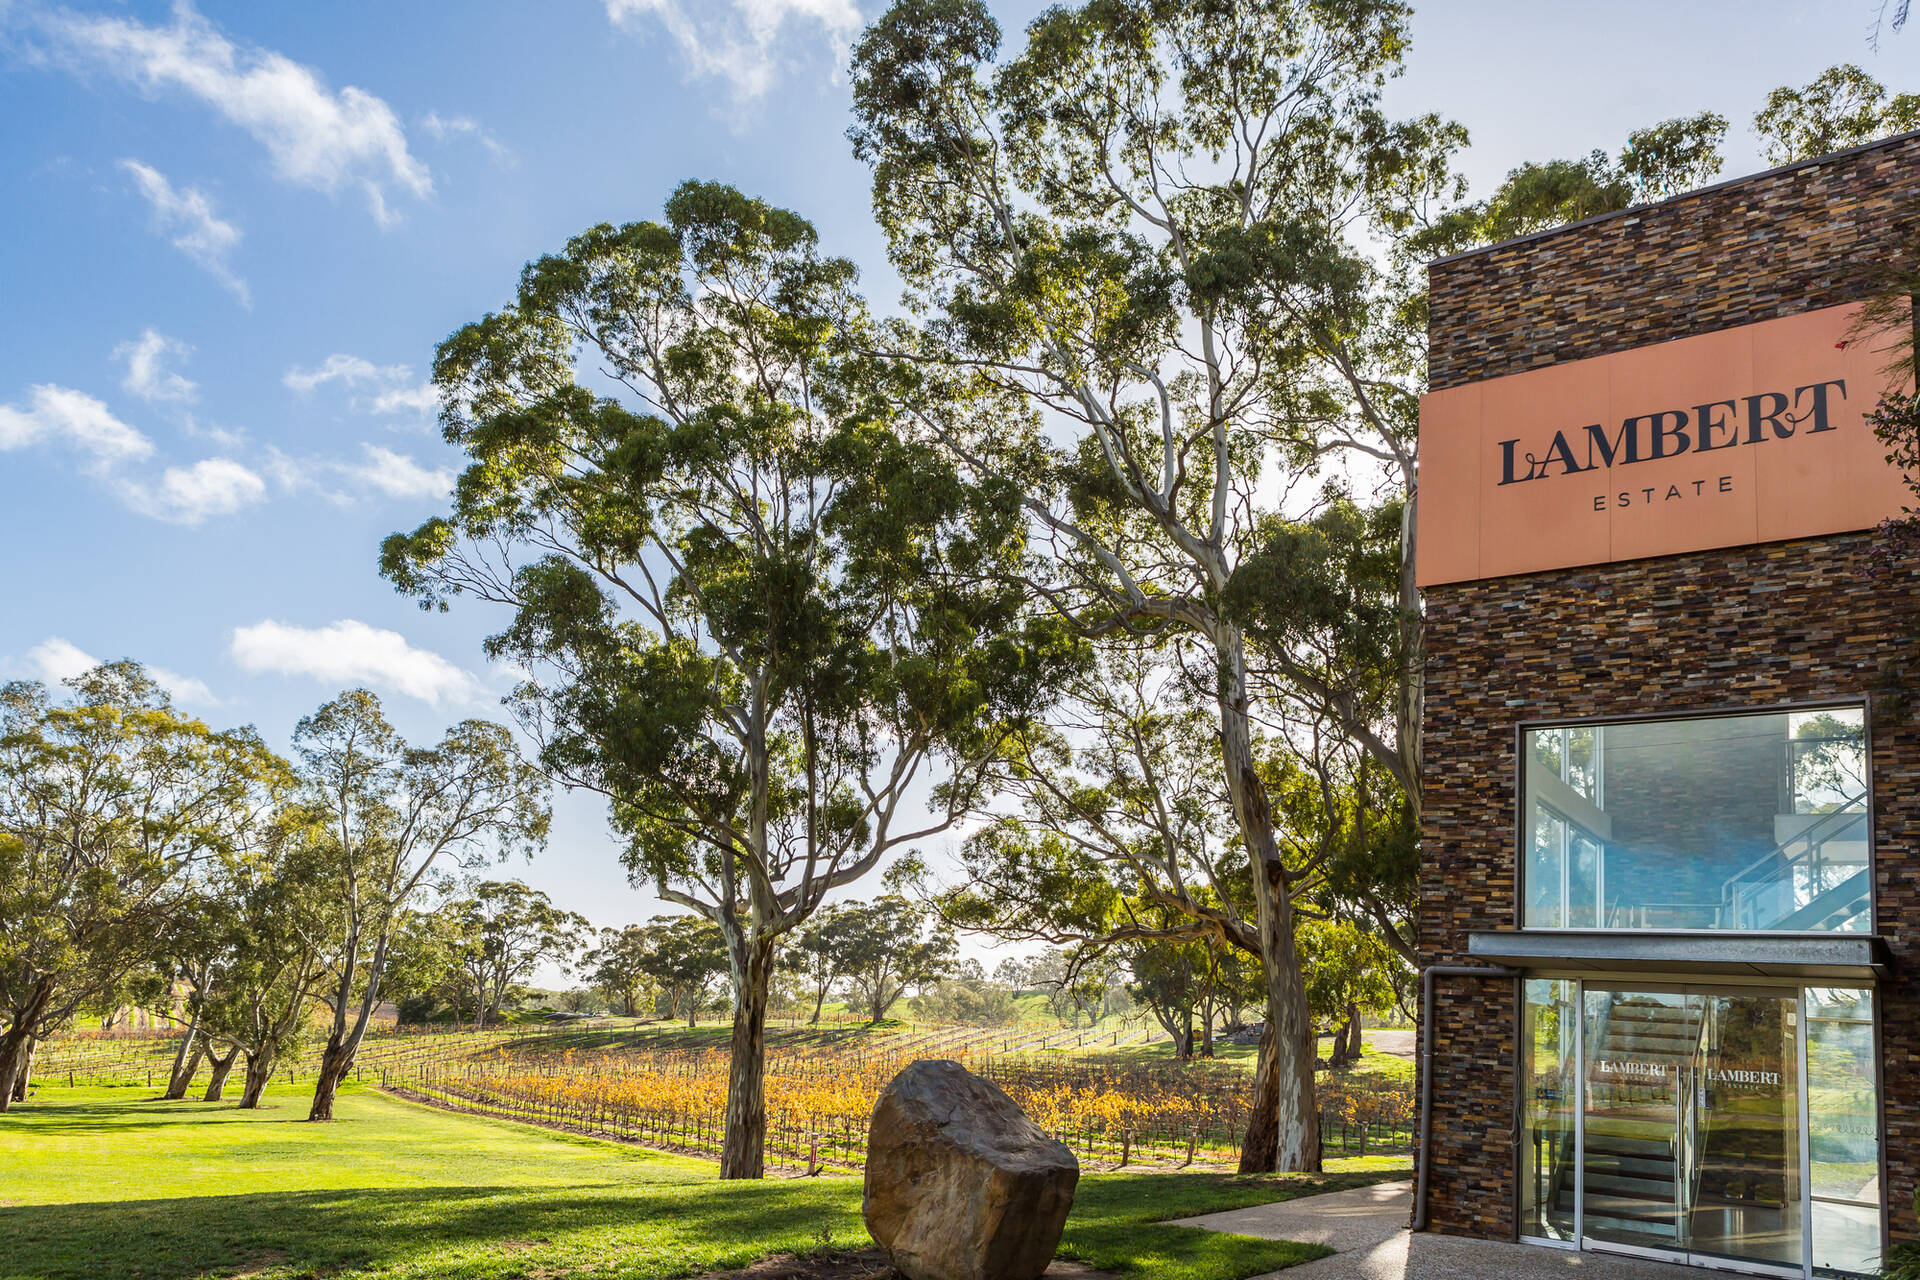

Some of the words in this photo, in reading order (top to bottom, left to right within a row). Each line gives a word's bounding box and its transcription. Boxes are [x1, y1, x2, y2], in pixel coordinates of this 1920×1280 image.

[1497, 379, 1847, 485] LAMBERT
[1593, 476, 1732, 511] ESTATE
[1600, 1060, 1668, 1076] LAMBERT
[1707, 1068, 1781, 1085] LAMBERT
